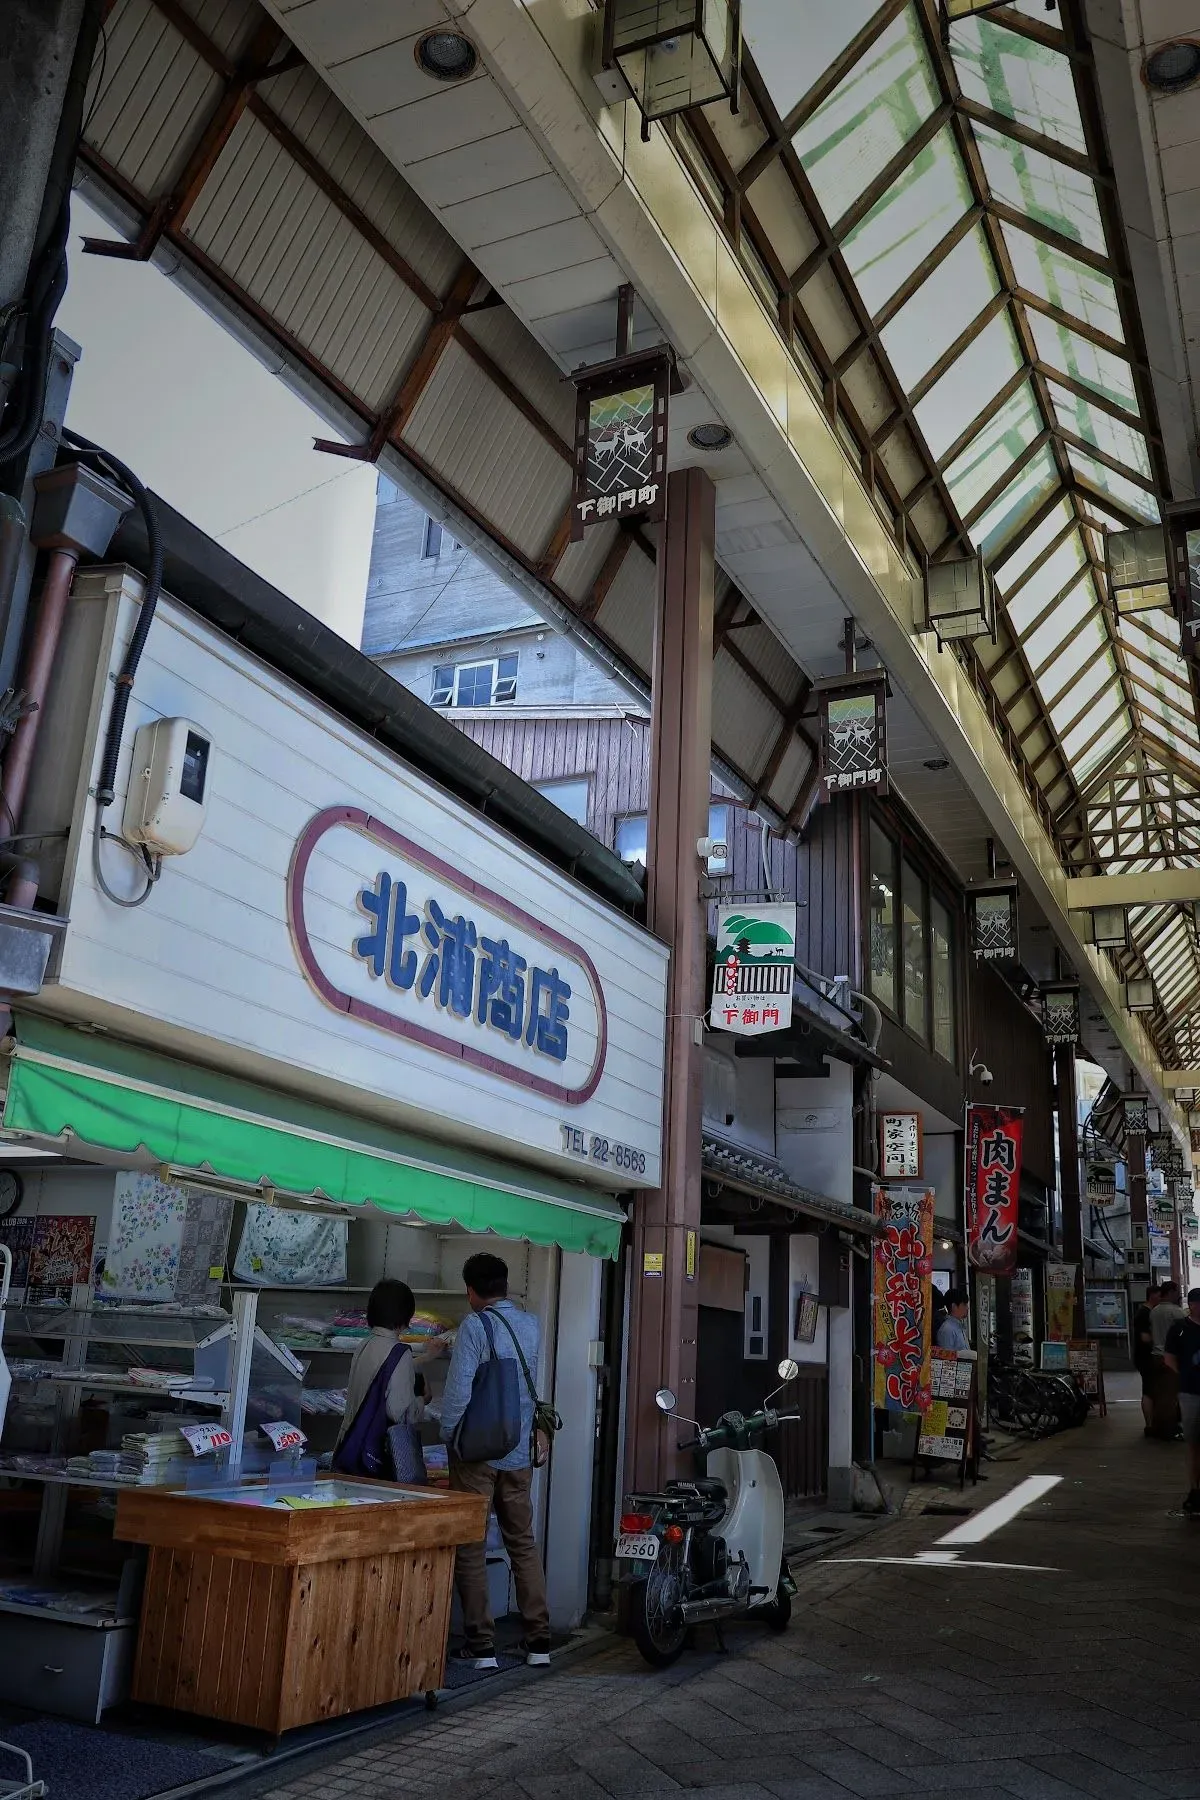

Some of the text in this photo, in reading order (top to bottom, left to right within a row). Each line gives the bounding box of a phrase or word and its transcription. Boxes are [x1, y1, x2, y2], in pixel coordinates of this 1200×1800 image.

[577, 484, 659, 521] 下御門町
[824, 768, 882, 789] 下御門町
[973, 947, 1015, 960] 下御門町
[352, 871, 572, 1062] 北浦商店
[722, 1008, 779, 1026] 下御門
[562, 1125, 646, 1174] TEL 22-8563
[981, 1128, 1016, 1245] 肉まん
[890, 1201, 920, 1221] 名物
[624, 1543, 655, 1557] 2560
